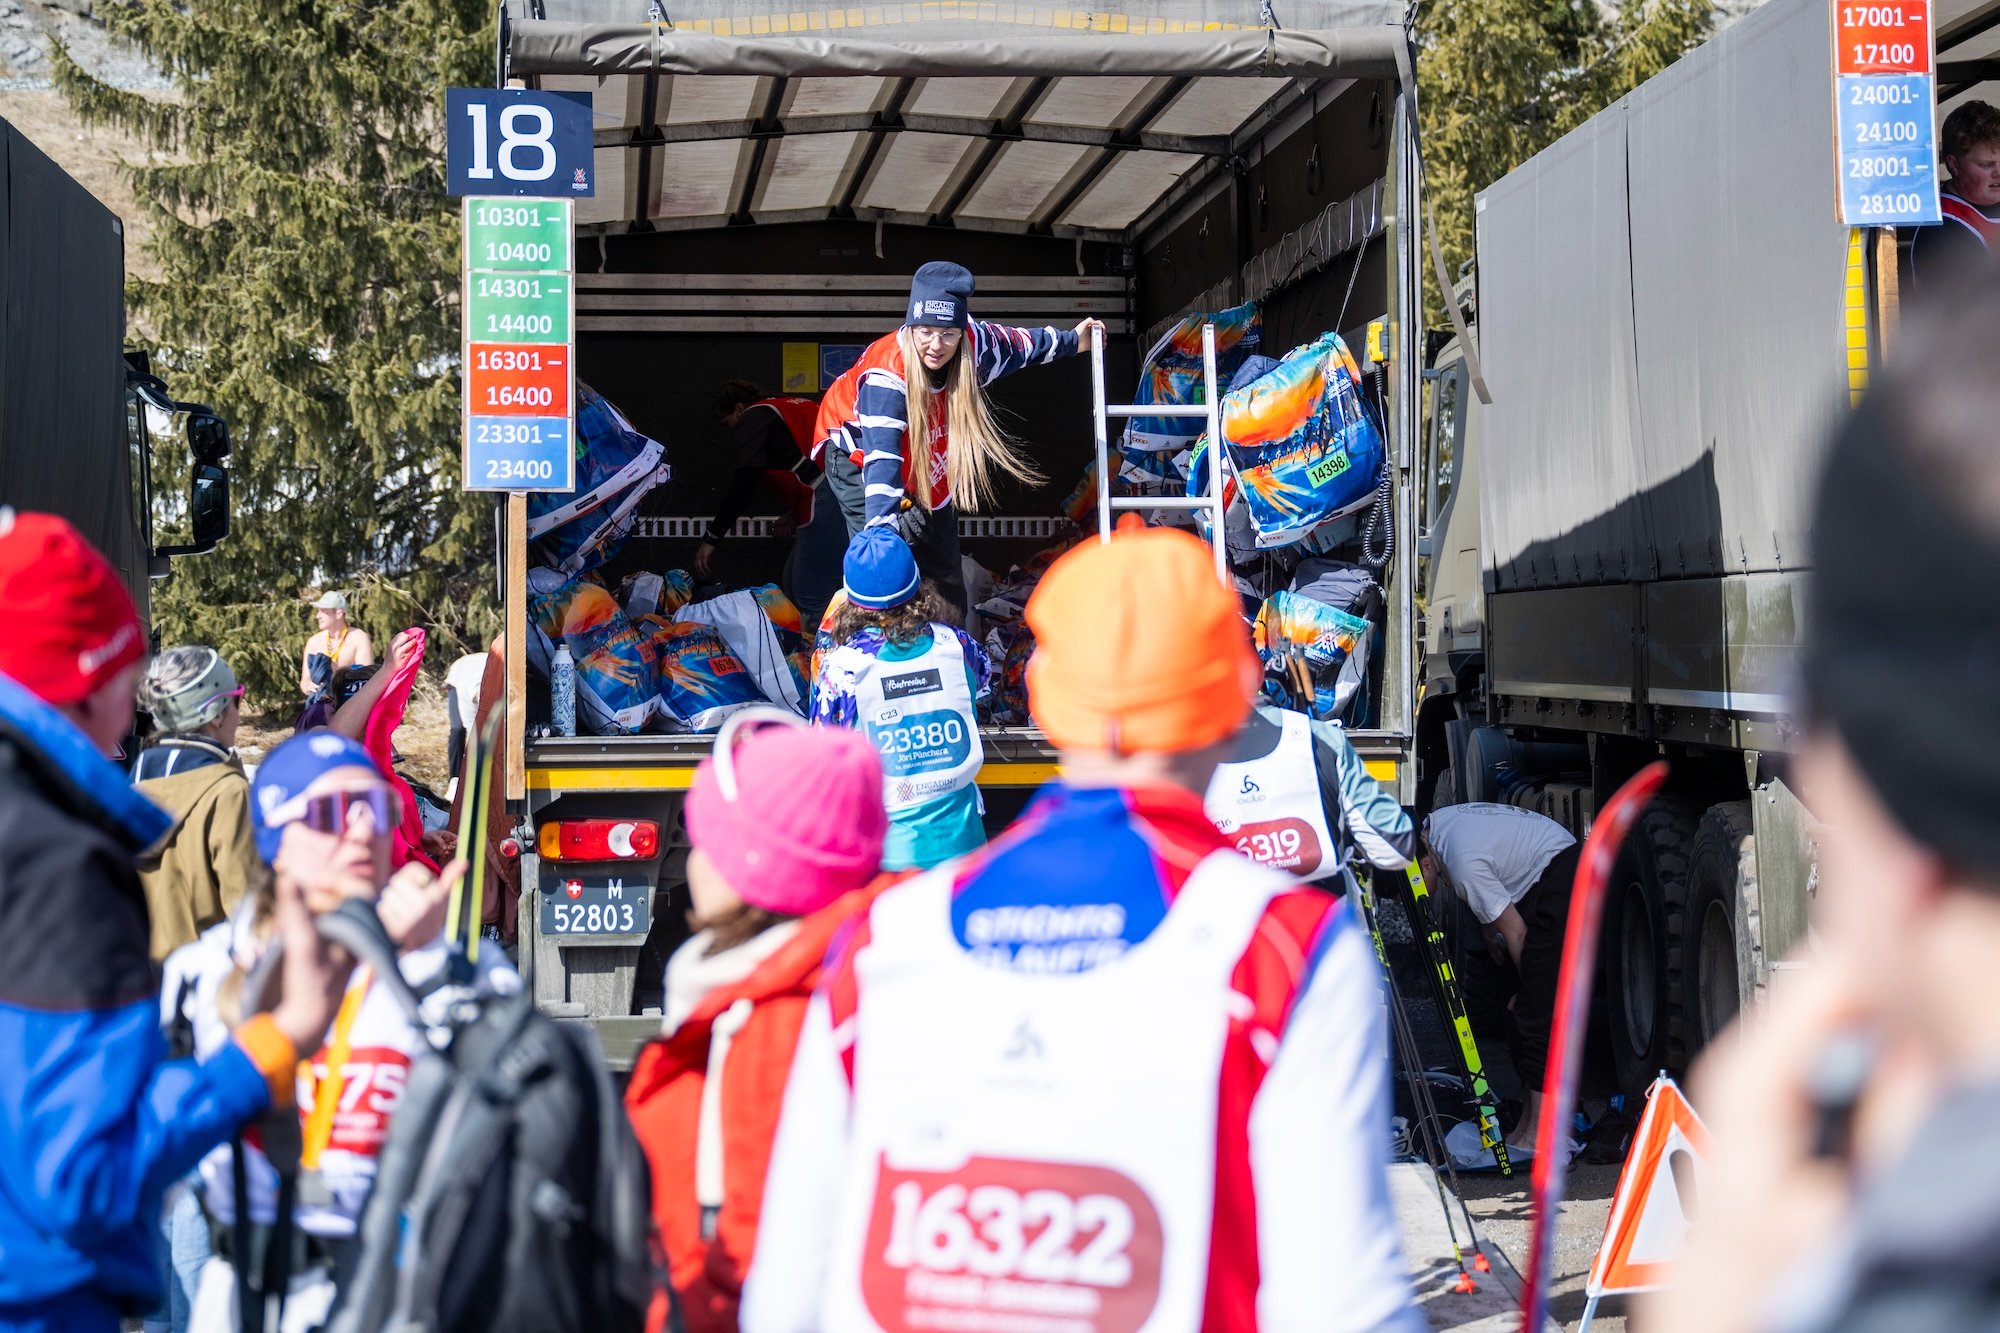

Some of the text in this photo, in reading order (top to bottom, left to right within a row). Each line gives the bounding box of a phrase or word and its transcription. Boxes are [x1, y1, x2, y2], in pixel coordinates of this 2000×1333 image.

[1843, 7, 1904, 27] 17001
[1853, 44, 1914, 64] 17100
[1851, 85, 1919, 105] 24001-
[1856, 122, 1917, 142] 24100
[467, 104, 557, 181] 18
[1849, 157, 1910, 178] 28001
[1860, 193, 1921, 214] 28100
[476, 207, 541, 227] 10301
[486, 243, 551, 262] 10400
[477, 279, 542, 299] 14301
[487, 314, 552, 334] 14400
[477, 351, 542, 371] 16301
[486, 386, 552, 406] 16400
[476, 425, 542, 444] 23301
[486, 460, 552, 479] 23400
[1312, 456, 1345, 483] 14398
[880, 709, 898, 721] C23
[877, 719, 963, 755] 23380
[1236, 828, 1301, 862] 6319
[607, 878, 623, 900] M
[554, 904, 634, 932] 52803
[1495, 1142, 1512, 1176] SPEE
[883, 1180, 1135, 1289] 16322
